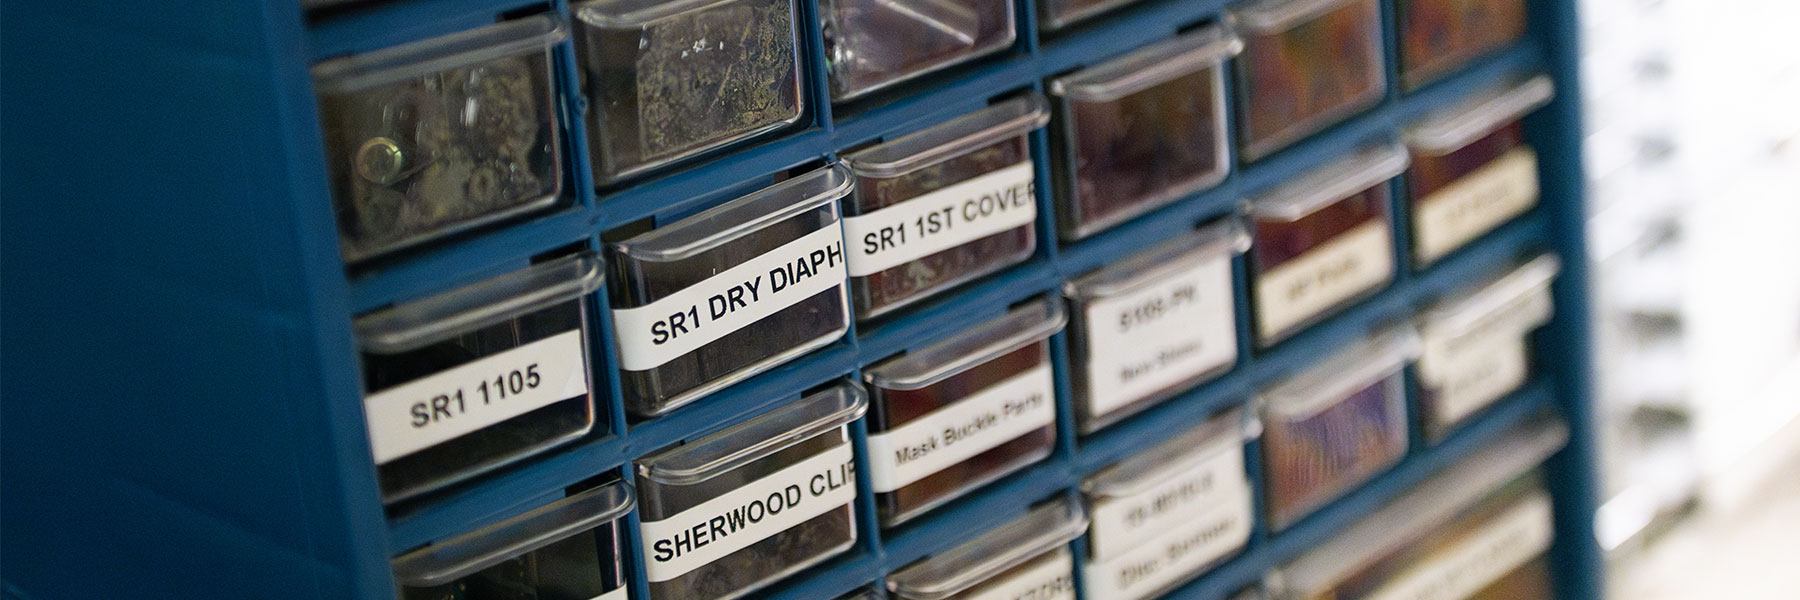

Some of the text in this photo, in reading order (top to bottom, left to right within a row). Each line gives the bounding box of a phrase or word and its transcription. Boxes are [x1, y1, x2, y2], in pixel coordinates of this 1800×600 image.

[863, 222, 907, 255] SR1
[916, 205, 955, 238] 1ST
[650, 240, 843, 346] SR1 DRY DIAPH
[409, 362, 541, 429] SR1 1105
[895, 432, 939, 465] Mask
[943, 412, 998, 447] Buckle
[652, 484, 802, 563] SHERWOOD
